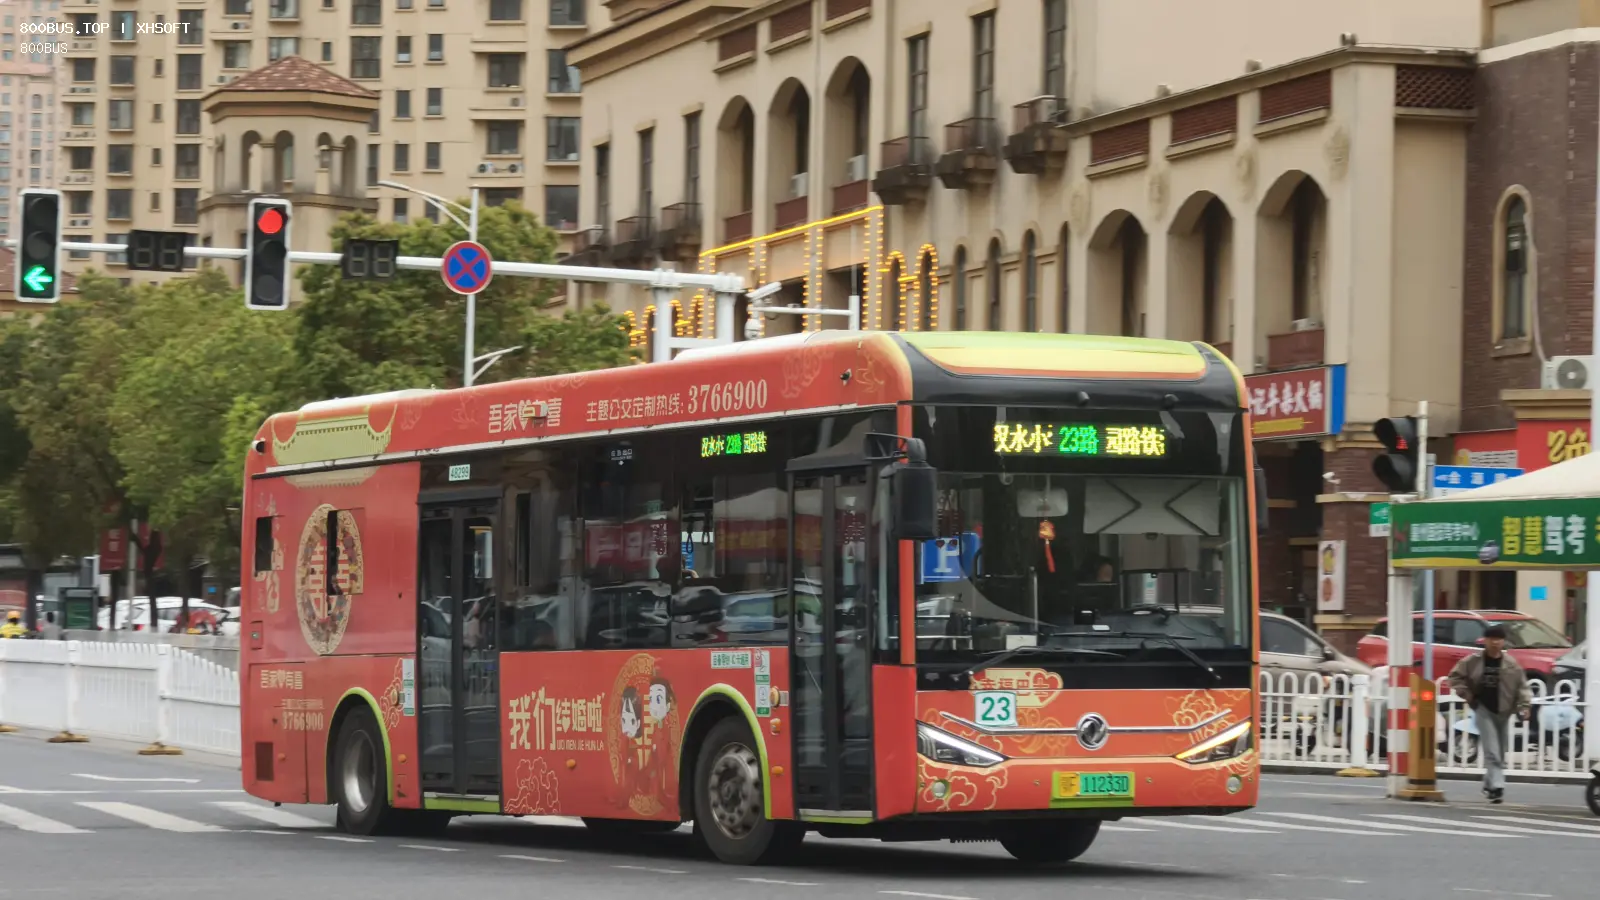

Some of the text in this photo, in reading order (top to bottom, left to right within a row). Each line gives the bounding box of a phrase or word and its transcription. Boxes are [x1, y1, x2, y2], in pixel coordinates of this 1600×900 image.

[688, 379, 768, 414] 3766900
[1059, 425, 1099, 454] 23路
[1503, 514, 1586, 555] 智慧驾考
[981, 696, 1010, 721] 23
